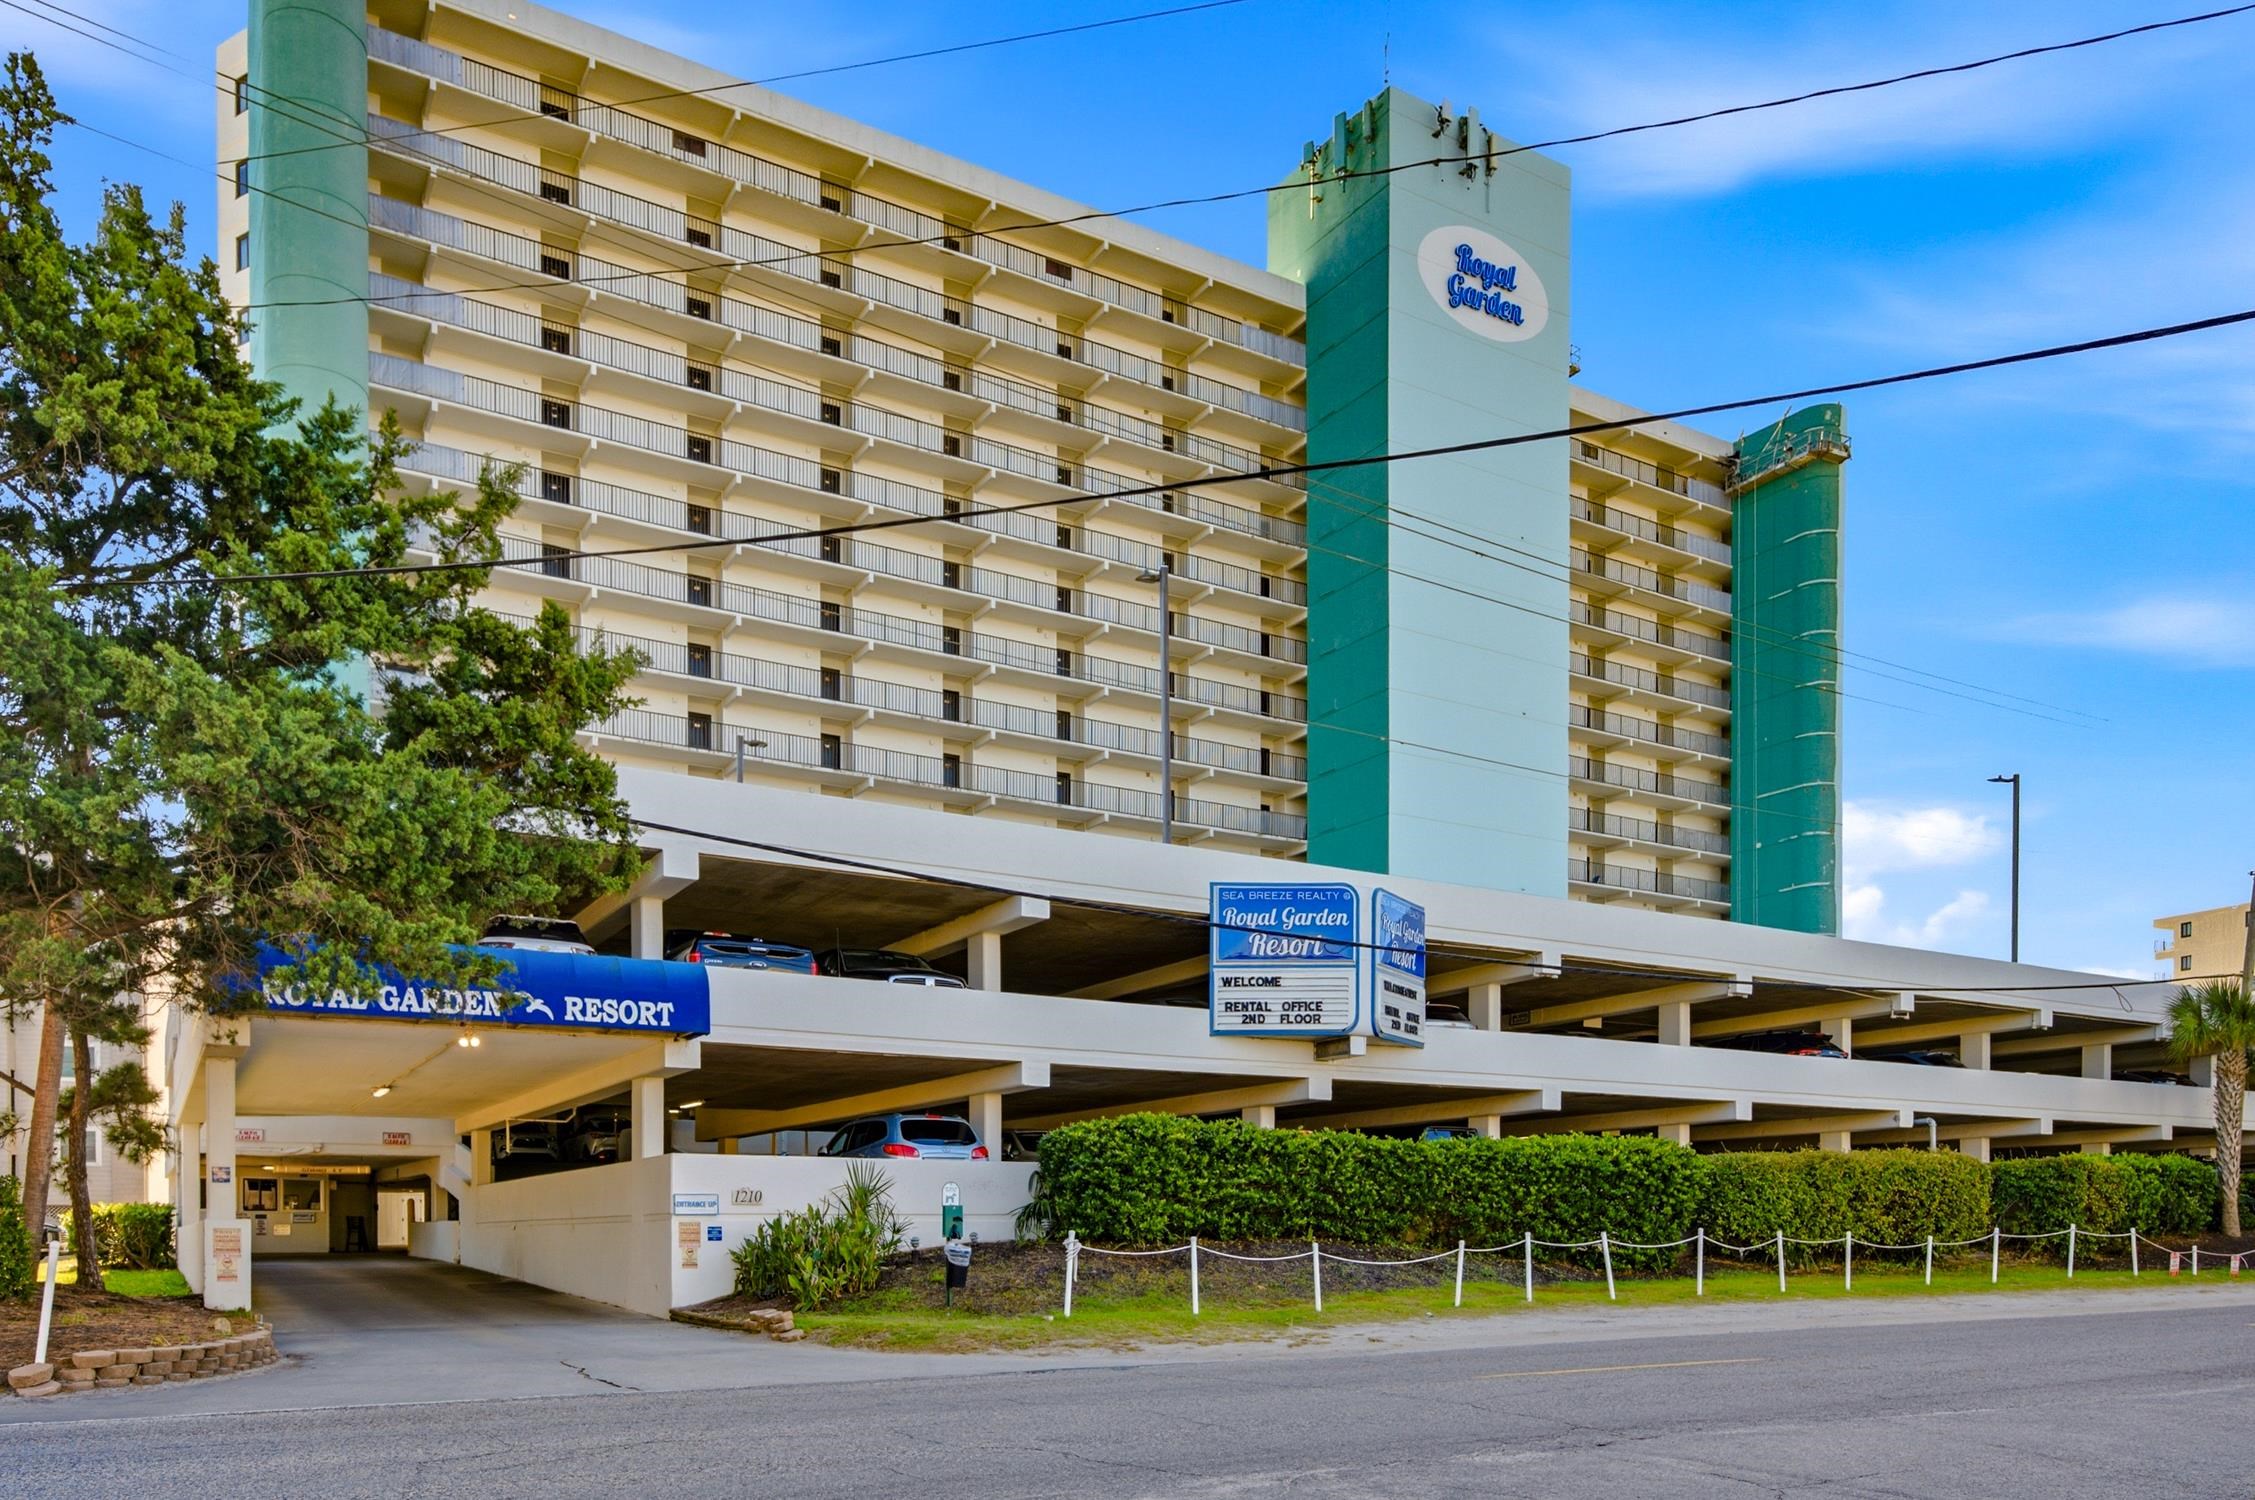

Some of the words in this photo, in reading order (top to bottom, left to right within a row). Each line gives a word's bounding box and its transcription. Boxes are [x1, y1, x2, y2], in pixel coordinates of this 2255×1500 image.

[1455, 243, 1518, 292] Royal
[1447, 273, 1525, 327] Garden
[1222, 891, 1245, 900] SEA
[1248, 891, 1293, 900] BREEZE
[1297, 891, 1340, 900] REALTY
[1222, 906, 1279, 930] Royal
[1281, 906, 1350, 931] Garden
[1381, 911, 1403, 940] Royal
[1402, 920, 1425, 947] Garden
[1249, 931, 1324, 957] Resort
[1391, 940, 1417, 971] Resort
[1221, 976, 1282, 988] WELCOME
[377, 985, 502, 1017] GARDEN
[564, 996, 675, 1027] RESORT
[1224, 1001, 1272, 1012] RENTAL
[1281, 1001, 1324, 1012] OFFICE
[1241, 1014, 1266, 1025] 2ND
[1280, 1014, 1322, 1025] FLOOR
[735, 1189, 763, 1204] 1210
